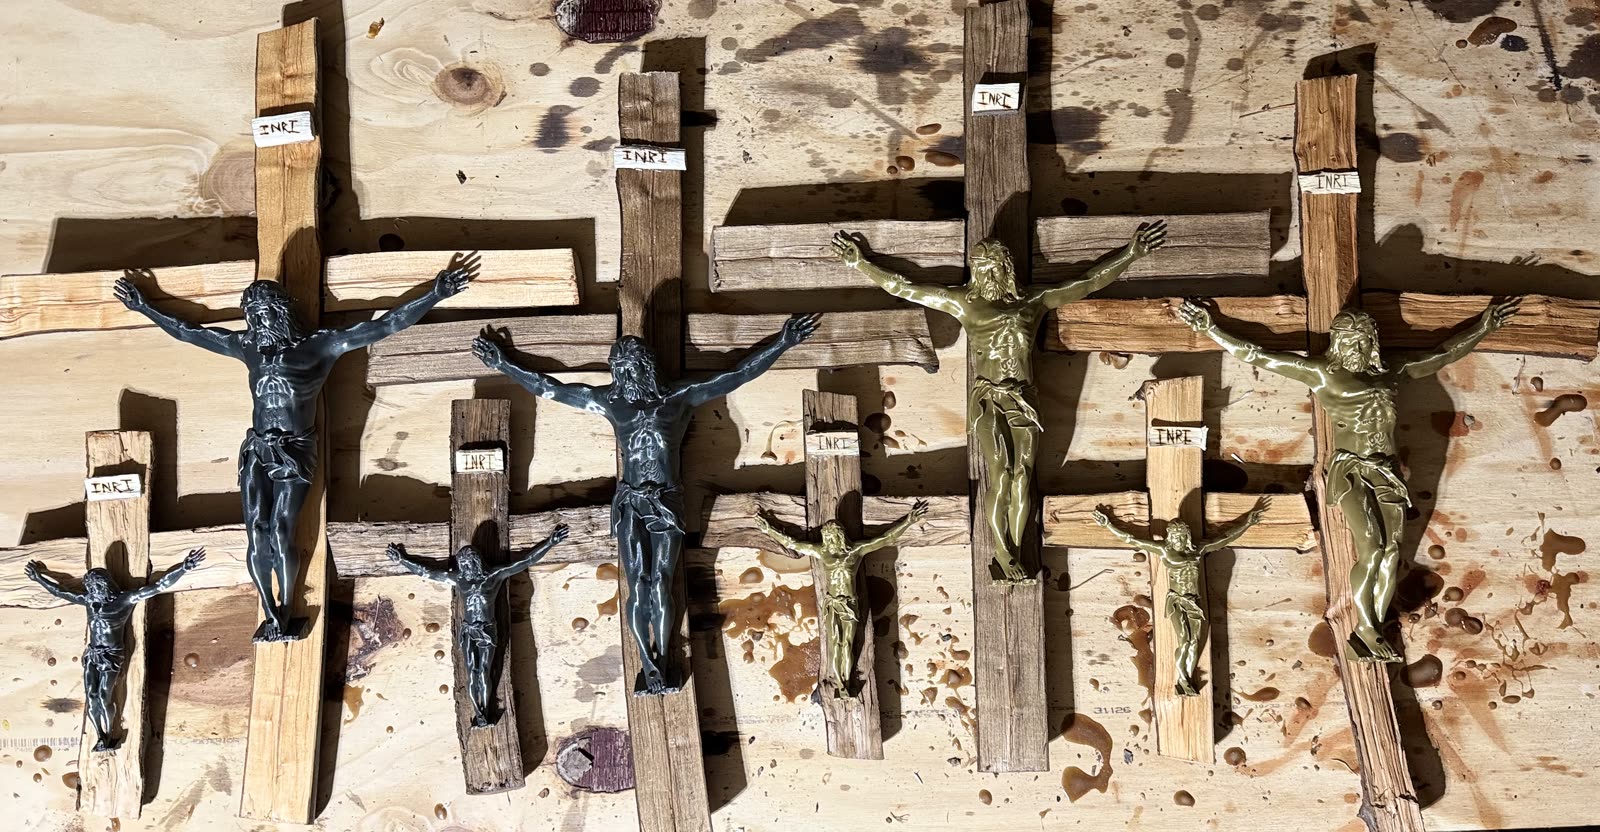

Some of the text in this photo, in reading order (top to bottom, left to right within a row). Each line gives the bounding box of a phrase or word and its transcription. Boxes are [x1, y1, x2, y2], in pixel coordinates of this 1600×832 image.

[977, 91, 1012, 109] INRI
[259, 120, 299, 136] INRI
[622, 150, 668, 164] INRI
[1315, 174, 1351, 190] INRI
[815, 435, 850, 451] INRI
[1155, 428, 1192, 445] INRI
[463, 453, 497, 470] INRI
[91, 479, 136, 494] INRI
[1093, 706, 1132, 714] 31126
